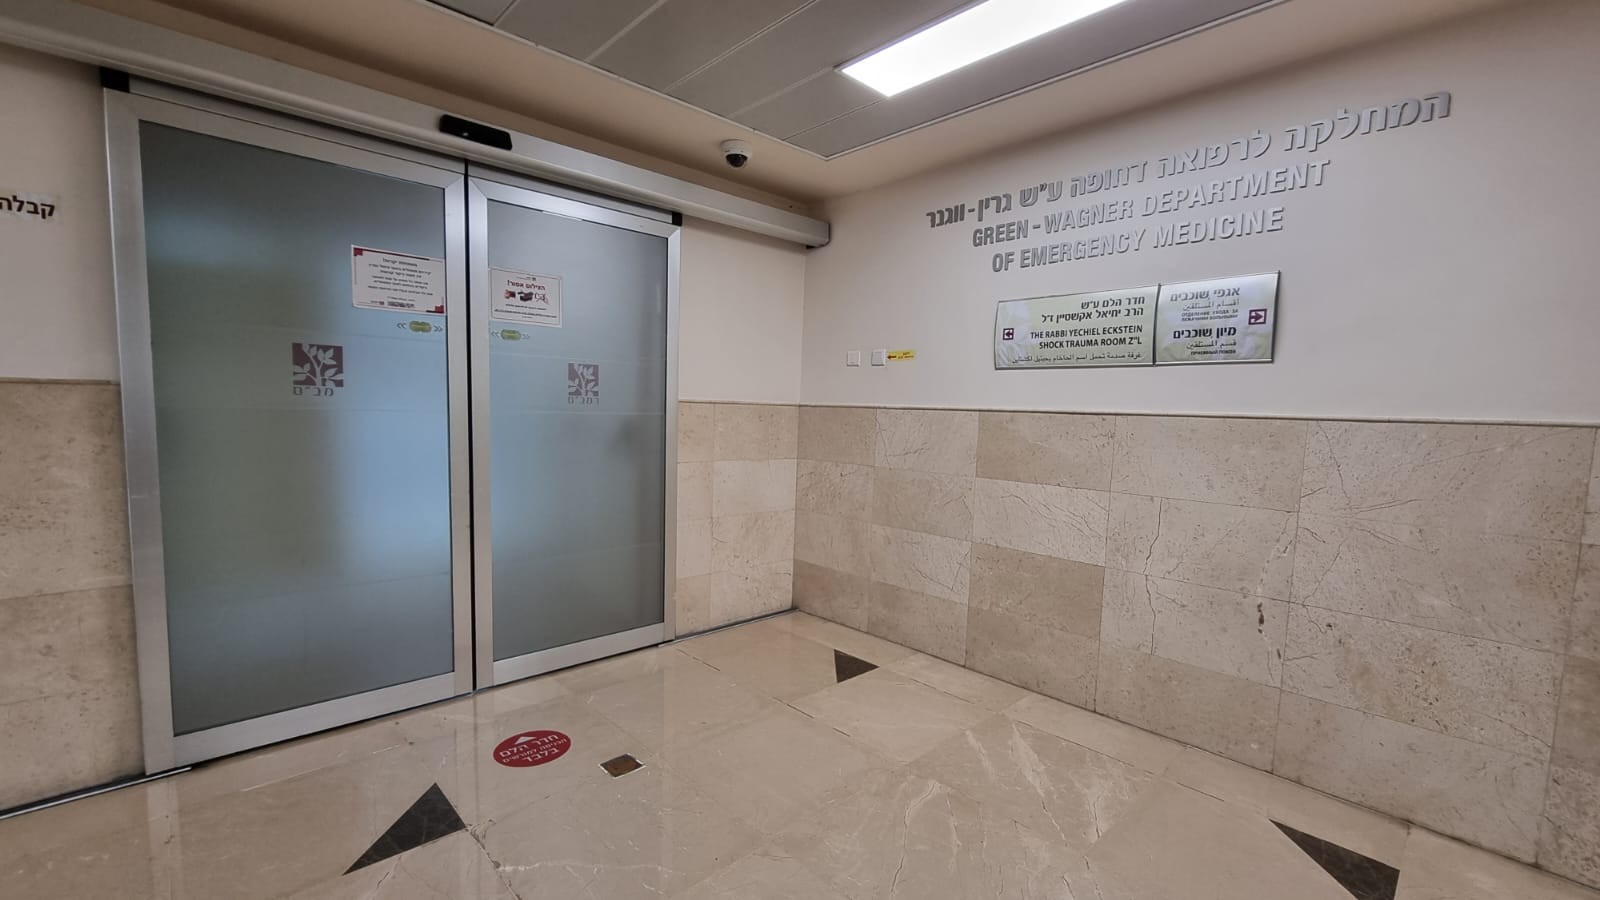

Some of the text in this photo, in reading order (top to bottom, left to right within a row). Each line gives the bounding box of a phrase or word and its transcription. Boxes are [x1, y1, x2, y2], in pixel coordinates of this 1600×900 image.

[1284, 91, 1452, 152] המחלקה
[1157, 129, 1272, 178] לרפואה
[1070, 160, 1148, 198] דחופה
[1141, 160, 1331, 217] DEPARTMENT
[0, 195, 55, 219] קבלה
[991, 206, 1285, 273] OF EMERGENCY MEDICINE
[1127, 296, 1146, 306] חדר
[1170, 287, 1241, 302] אגפי שוכבים
[1102, 298, 1122, 308] הלם
[1096, 309, 1121, 319] יחיאל
[1124, 307, 1144, 317] הרב
[1031, 325, 1143, 339] THE RABBI YECHIEL ECKSTEIN
[1173, 326, 1237, 339] מיון שוכבים
[1039, 341, 1065, 349] SHOCK
[1065, 339, 1099, 348] TRAUMA
[1100, 337, 1127, 346] ROOM
[500, 735, 559, 757] חדר הלם
[522, 747, 559, 762] בלבד
